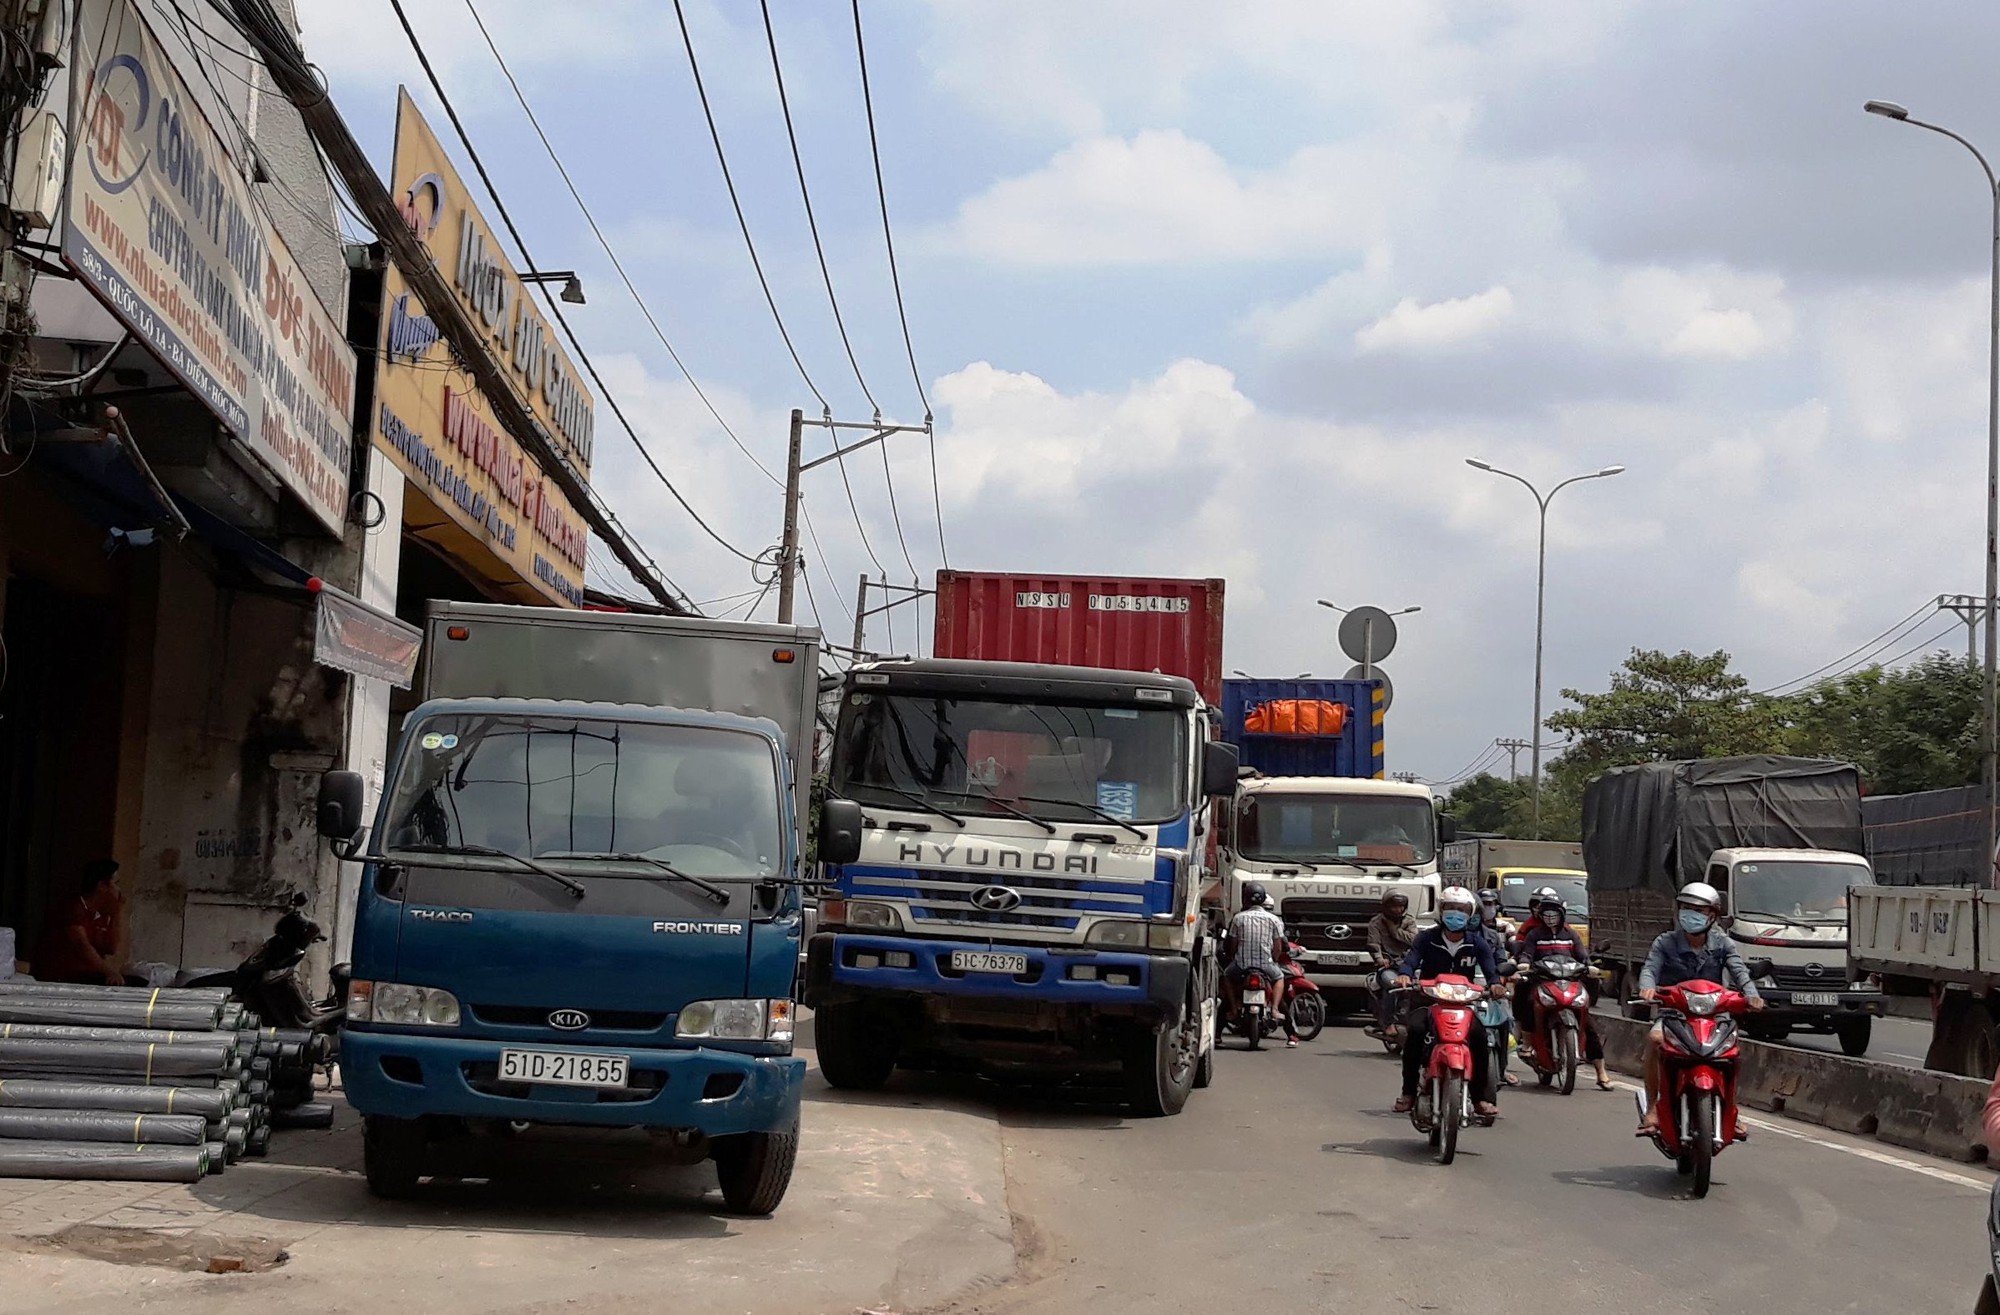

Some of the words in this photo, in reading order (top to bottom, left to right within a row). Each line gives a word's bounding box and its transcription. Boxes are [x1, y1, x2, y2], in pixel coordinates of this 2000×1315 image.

[154, 96, 205, 218] CÔNG
[204, 168, 224, 245] TY
[224, 199, 263, 298] NHỰA
[263, 255, 303, 354] ĐỨC
[305, 316, 351, 418] THỊNH
[85, 192, 246, 397] www.nhuaducthinh.com
[81, 247, 102, 281] 58/3
[108, 276, 138, 320] QUỐC
[139, 307, 154, 338] LỘ
[155, 324, 166, 350] 1A
[173, 343, 184, 369] BÀ
[211, 384, 227, 413] HÓC
[227, 400, 244, 430] MÔN
[1017, 593, 1069, 606] NSSU
[1089, 596, 1188, 611] 0055445
[900, 843, 1098, 874] HYUNDAI
[410, 909, 473, 922] THACO
[653, 921, 742, 935] FRONTIER
[556, 1014, 582, 1025] KIA
[505, 1053, 623, 1082] 51D-218.55
